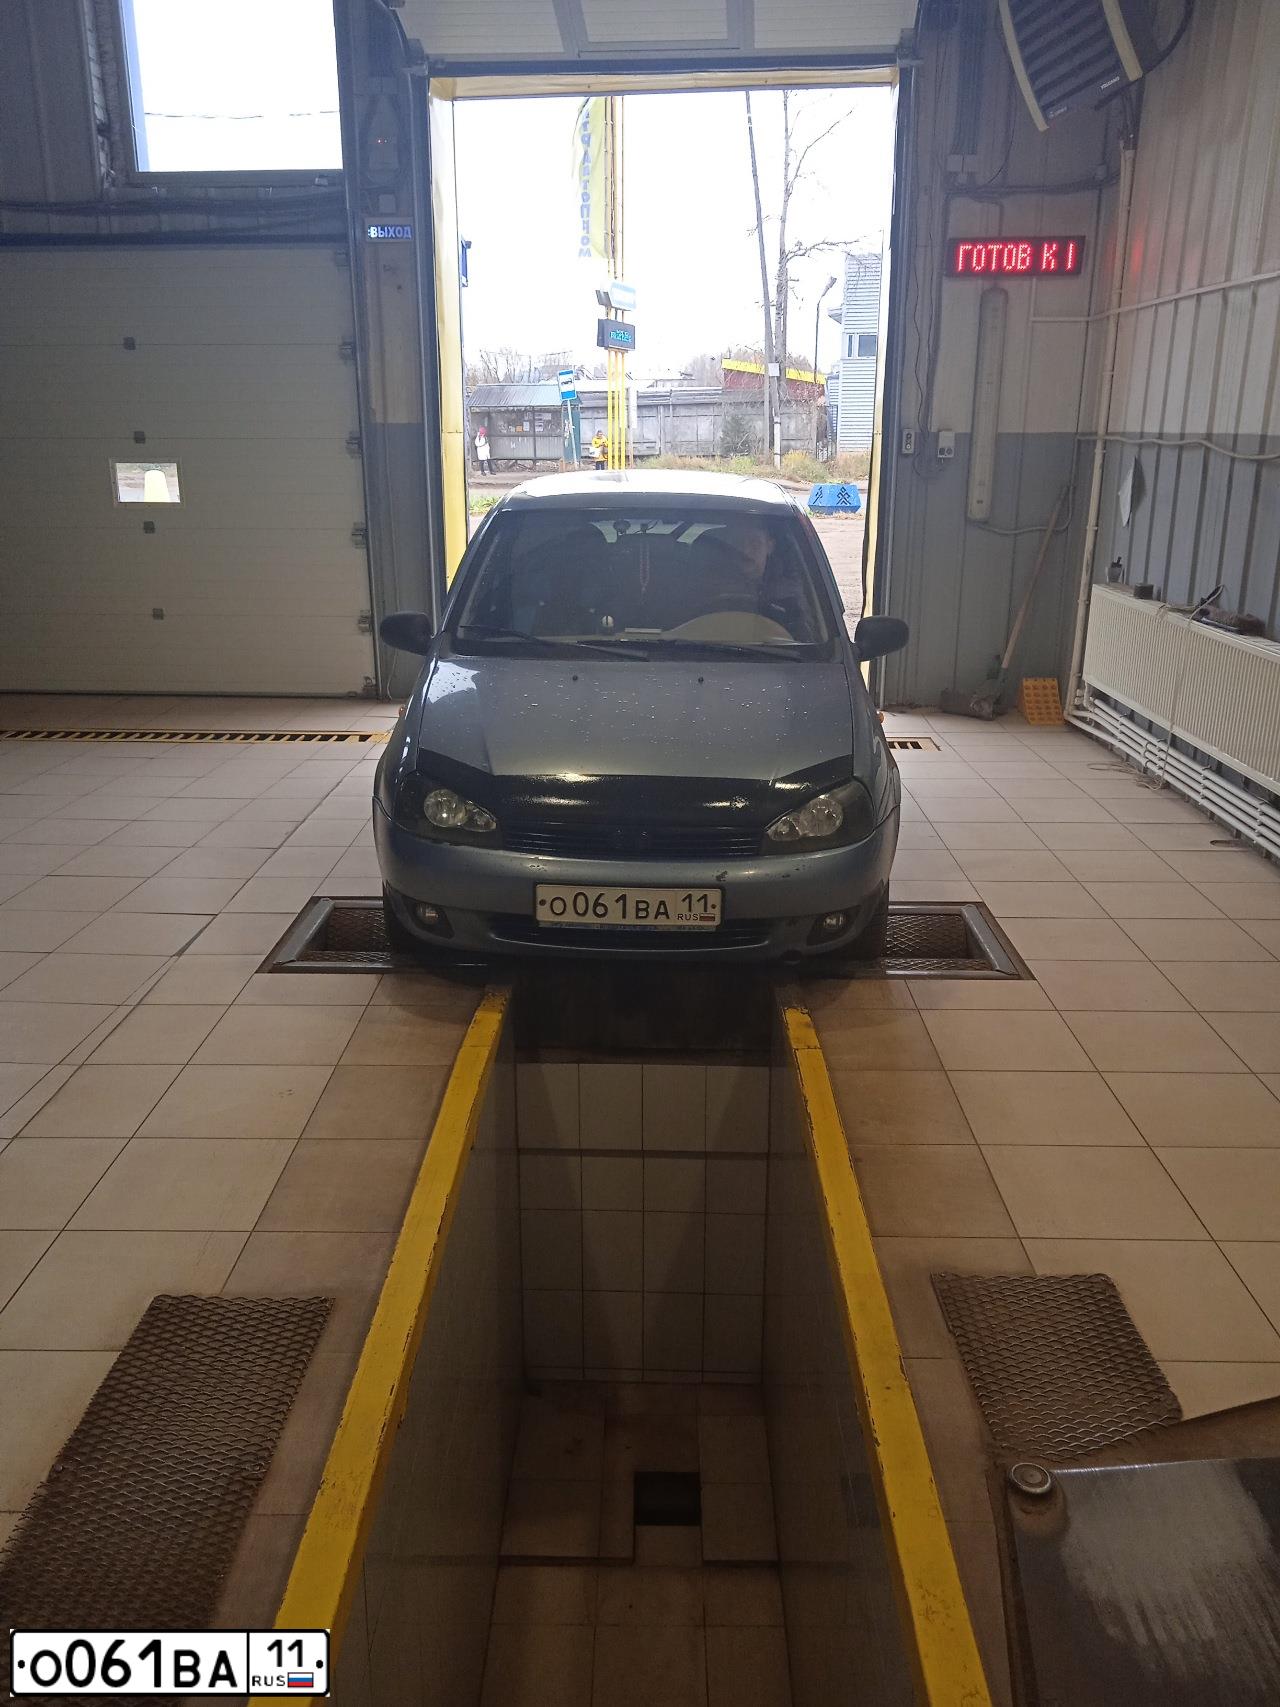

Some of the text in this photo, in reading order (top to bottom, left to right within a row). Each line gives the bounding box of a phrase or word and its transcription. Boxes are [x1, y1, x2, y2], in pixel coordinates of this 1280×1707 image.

[370, 226, 412, 238] ВЫХОД
[958, 243, 1031, 272] ГОТОВ
[681, 893, 708, 912] 11
[677, 913, 699, 921] RUS
